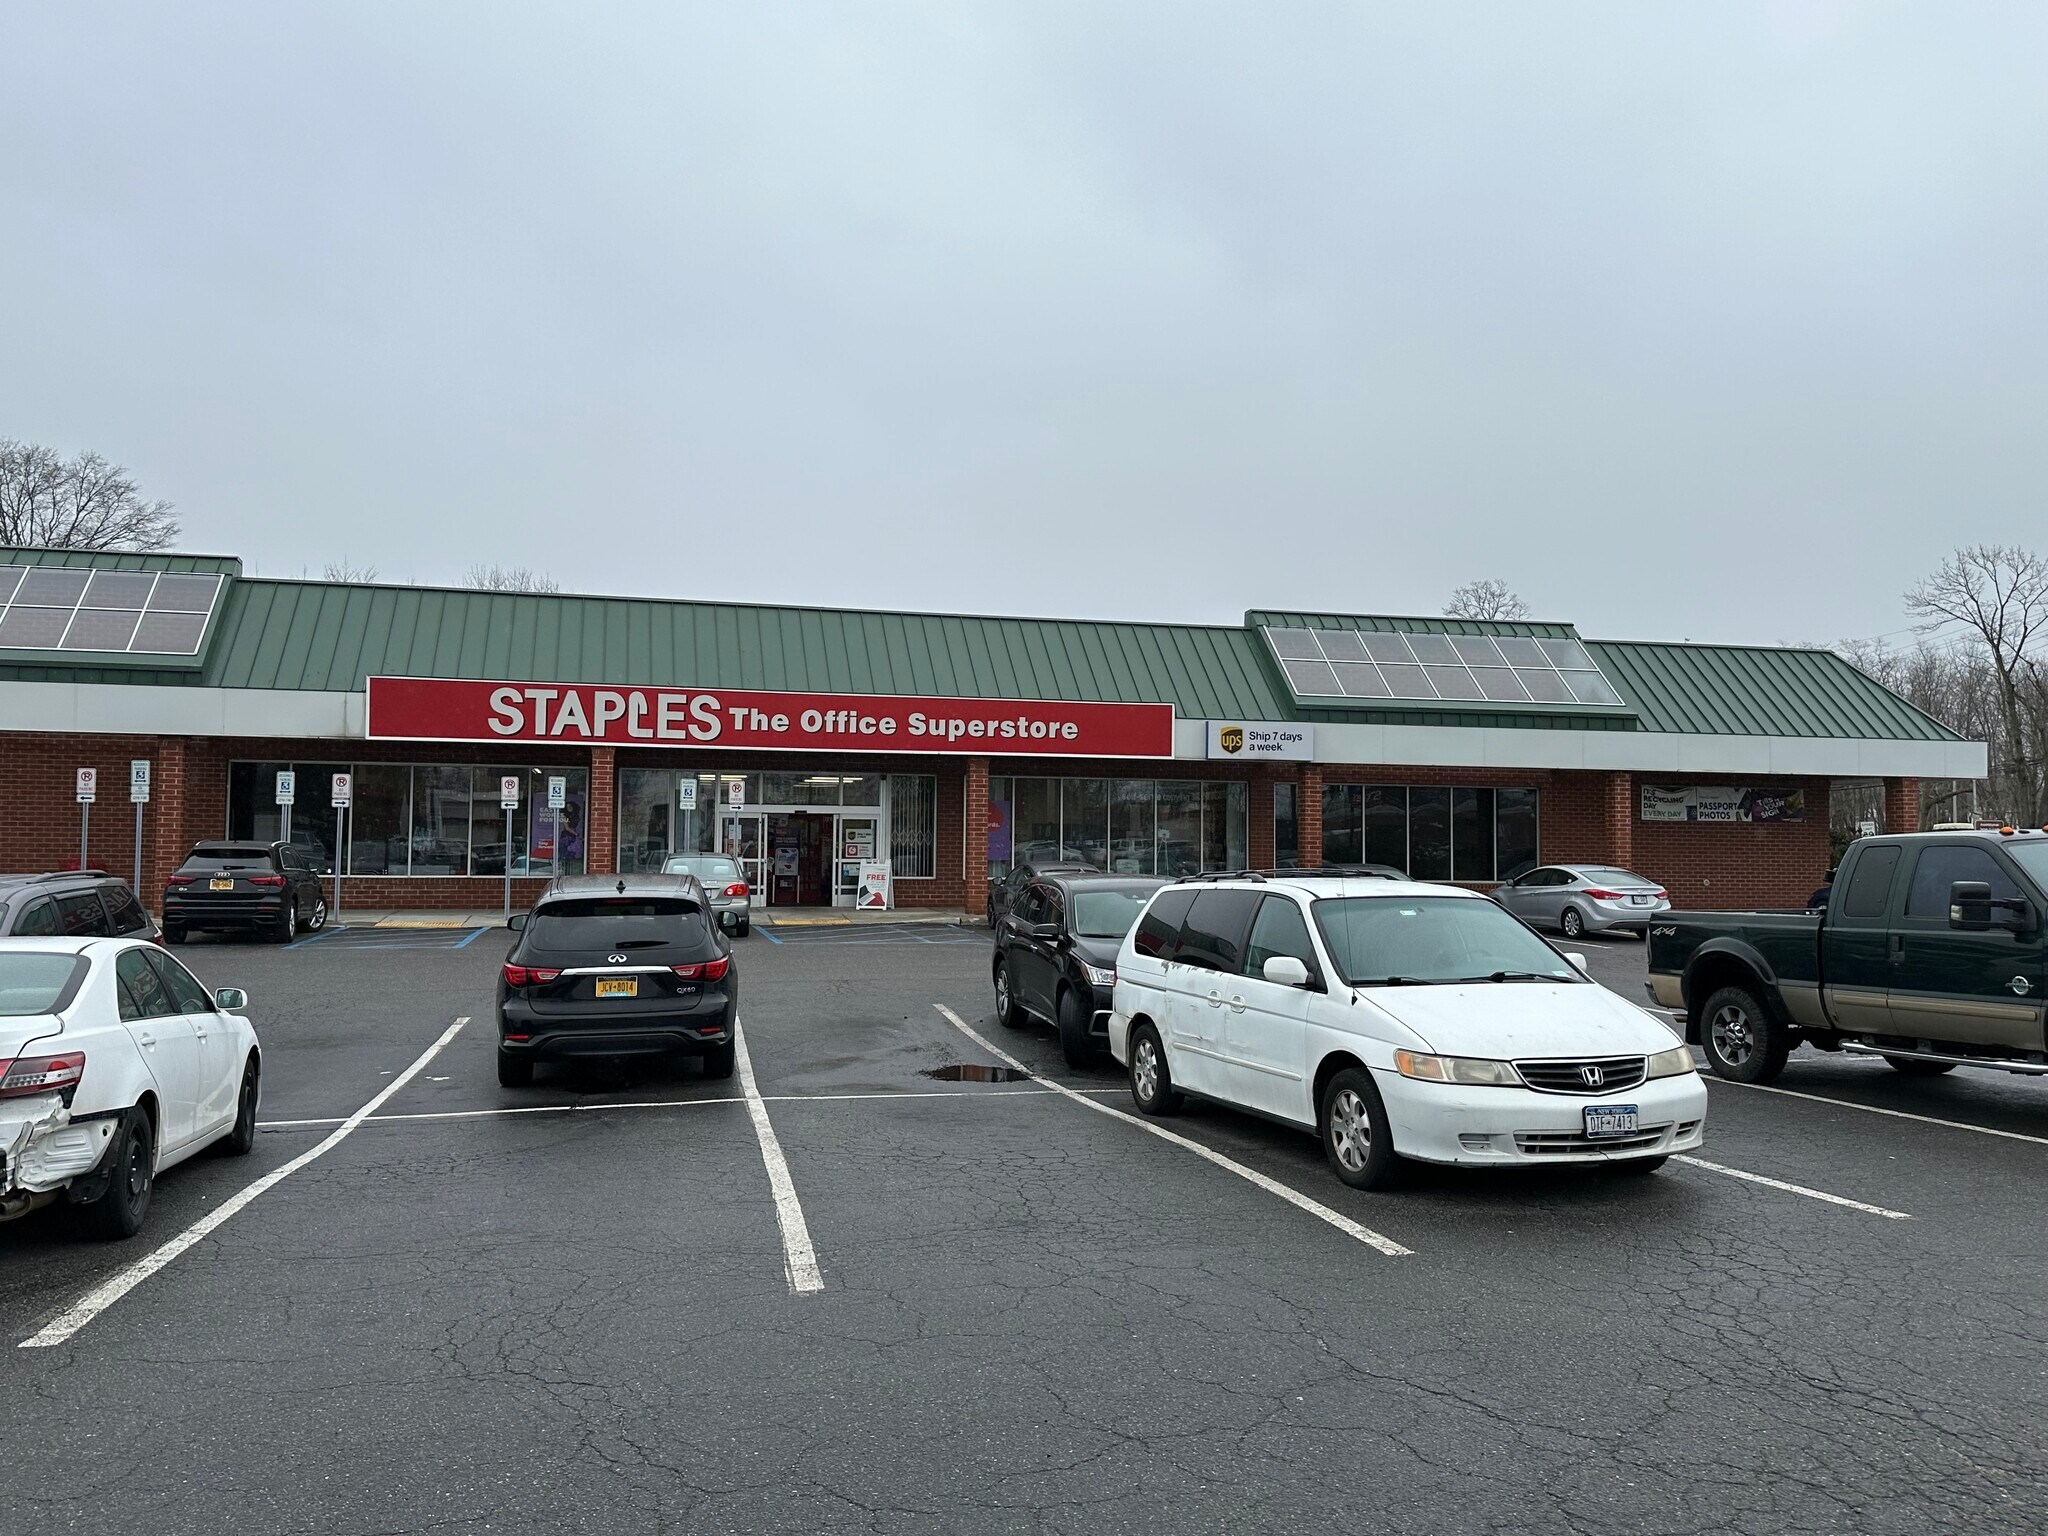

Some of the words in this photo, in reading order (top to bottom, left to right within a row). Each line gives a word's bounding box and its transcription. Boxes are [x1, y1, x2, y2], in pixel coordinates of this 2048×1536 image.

[487, 687, 722, 742] STAPLES
[728, 707, 790, 733] The
[800, 708, 898, 736] Office
[907, 712, 1079, 743] Superstore
[1249, 731, 1271, 741] Ship
[1272, 732, 1279, 740] 7
[1280, 732, 1303, 742] days
[1222, 735, 1242, 751] ups
[1643, 795, 1684, 803] RECYCLING
[1699, 802, 1738, 811] PASSPORT
[1764, 800, 1785, 811] YOUR
[1699, 811, 1731, 820] PHOTOS
[1652, 926, 1677, 936] 4x4
[600, 982, 613, 993] JCV
[617, 981, 634, 992] 8014
[1612, 1115, 1633, 1130] 7413
